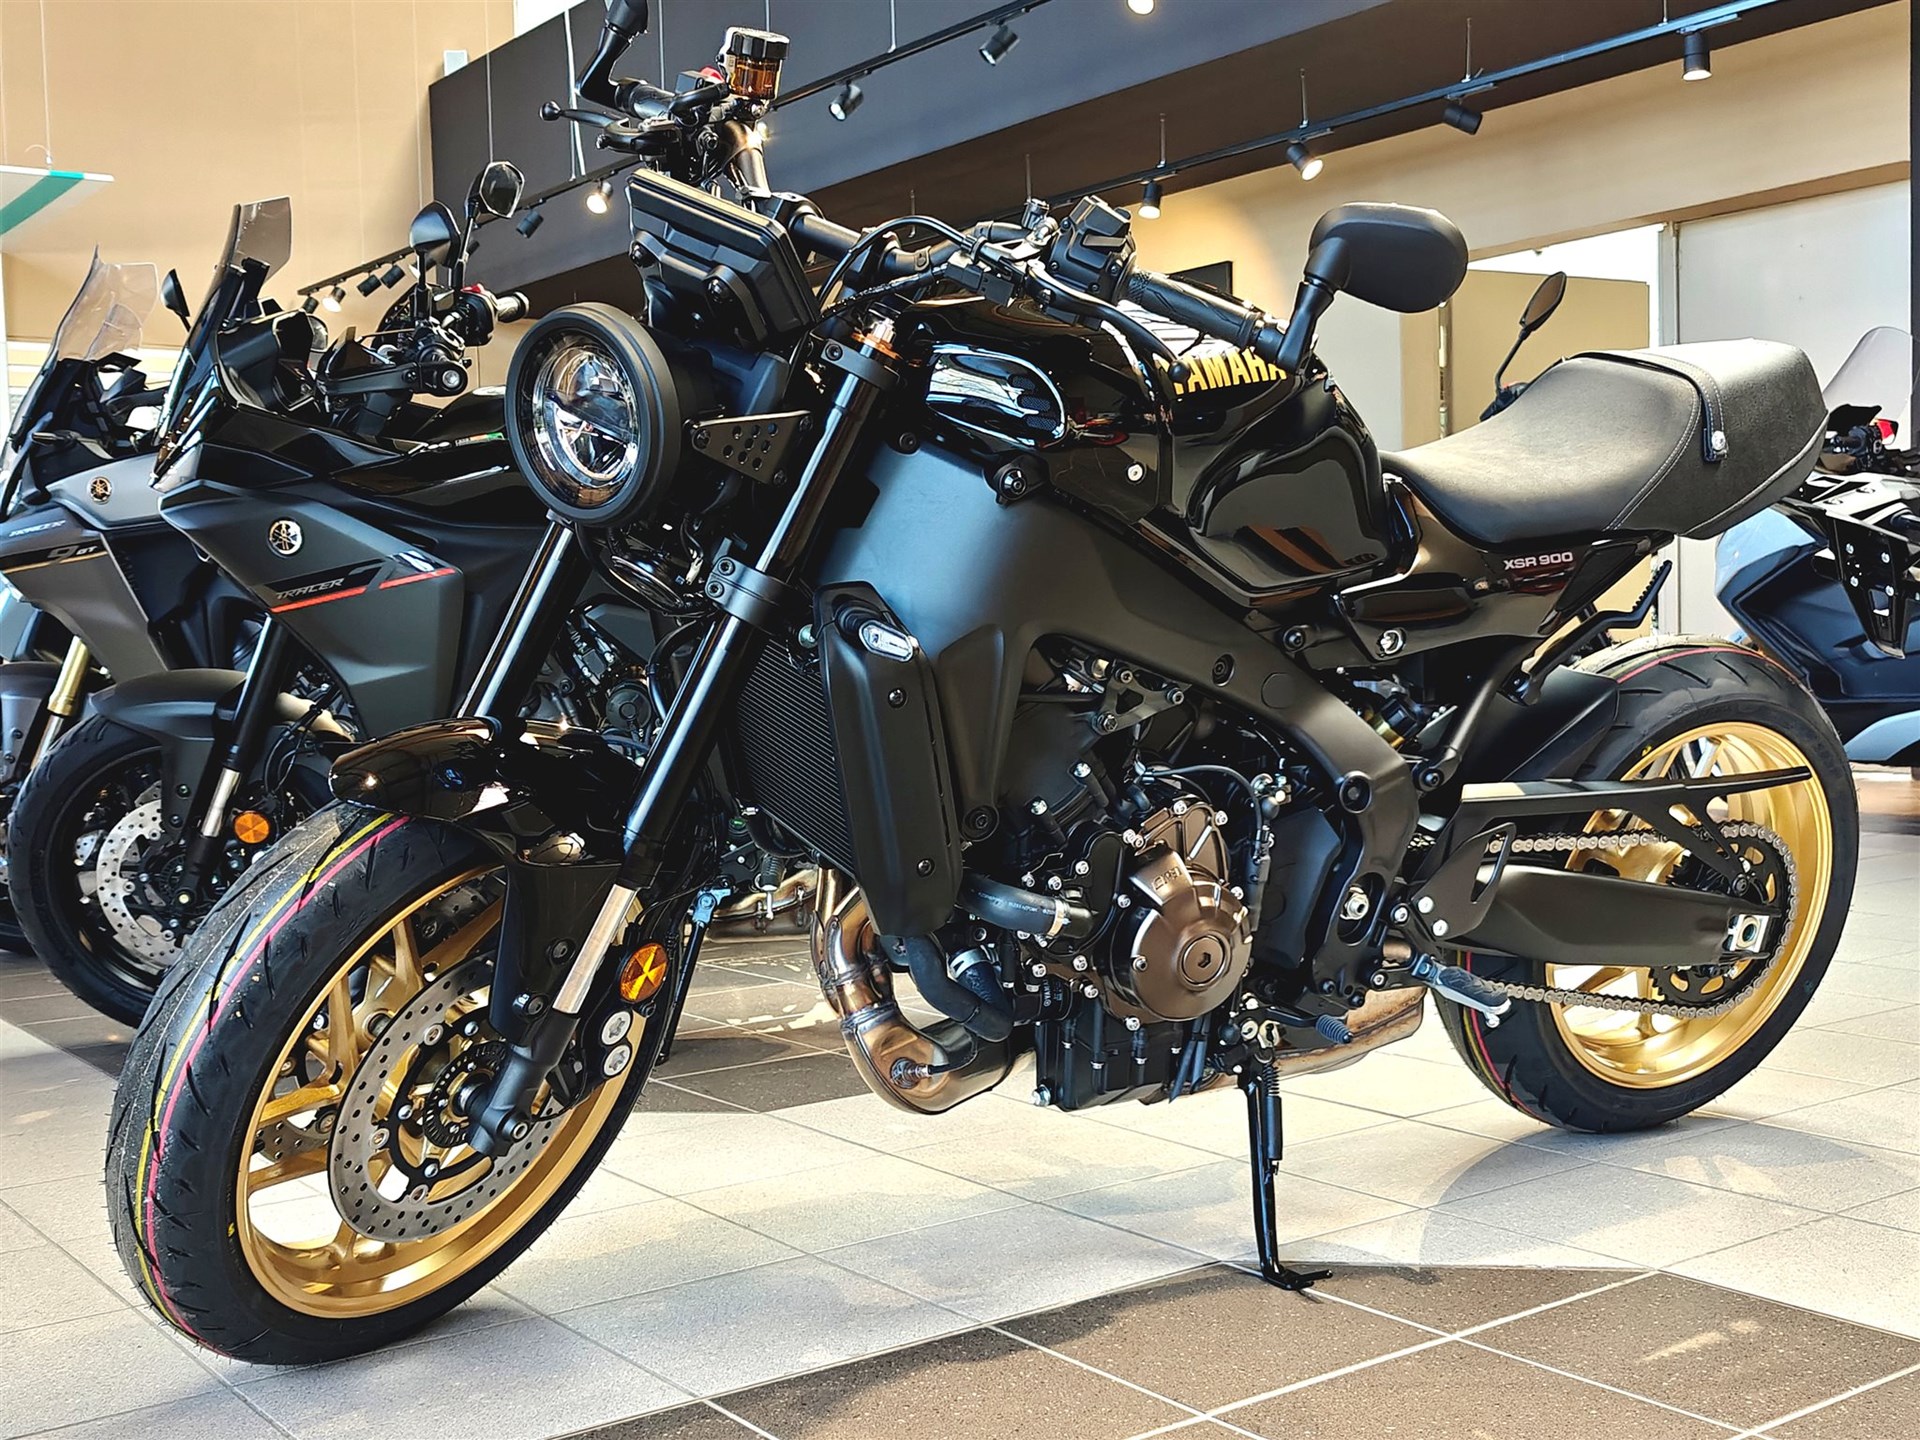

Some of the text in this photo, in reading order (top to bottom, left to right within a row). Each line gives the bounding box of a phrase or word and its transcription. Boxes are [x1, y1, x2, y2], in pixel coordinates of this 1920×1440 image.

[1169, 348, 1288, 396] AMAHA
[76, 546, 98, 555] GT
[1503, 551, 1574, 571] XSR 900
[275, 577, 345, 600] TRACER
